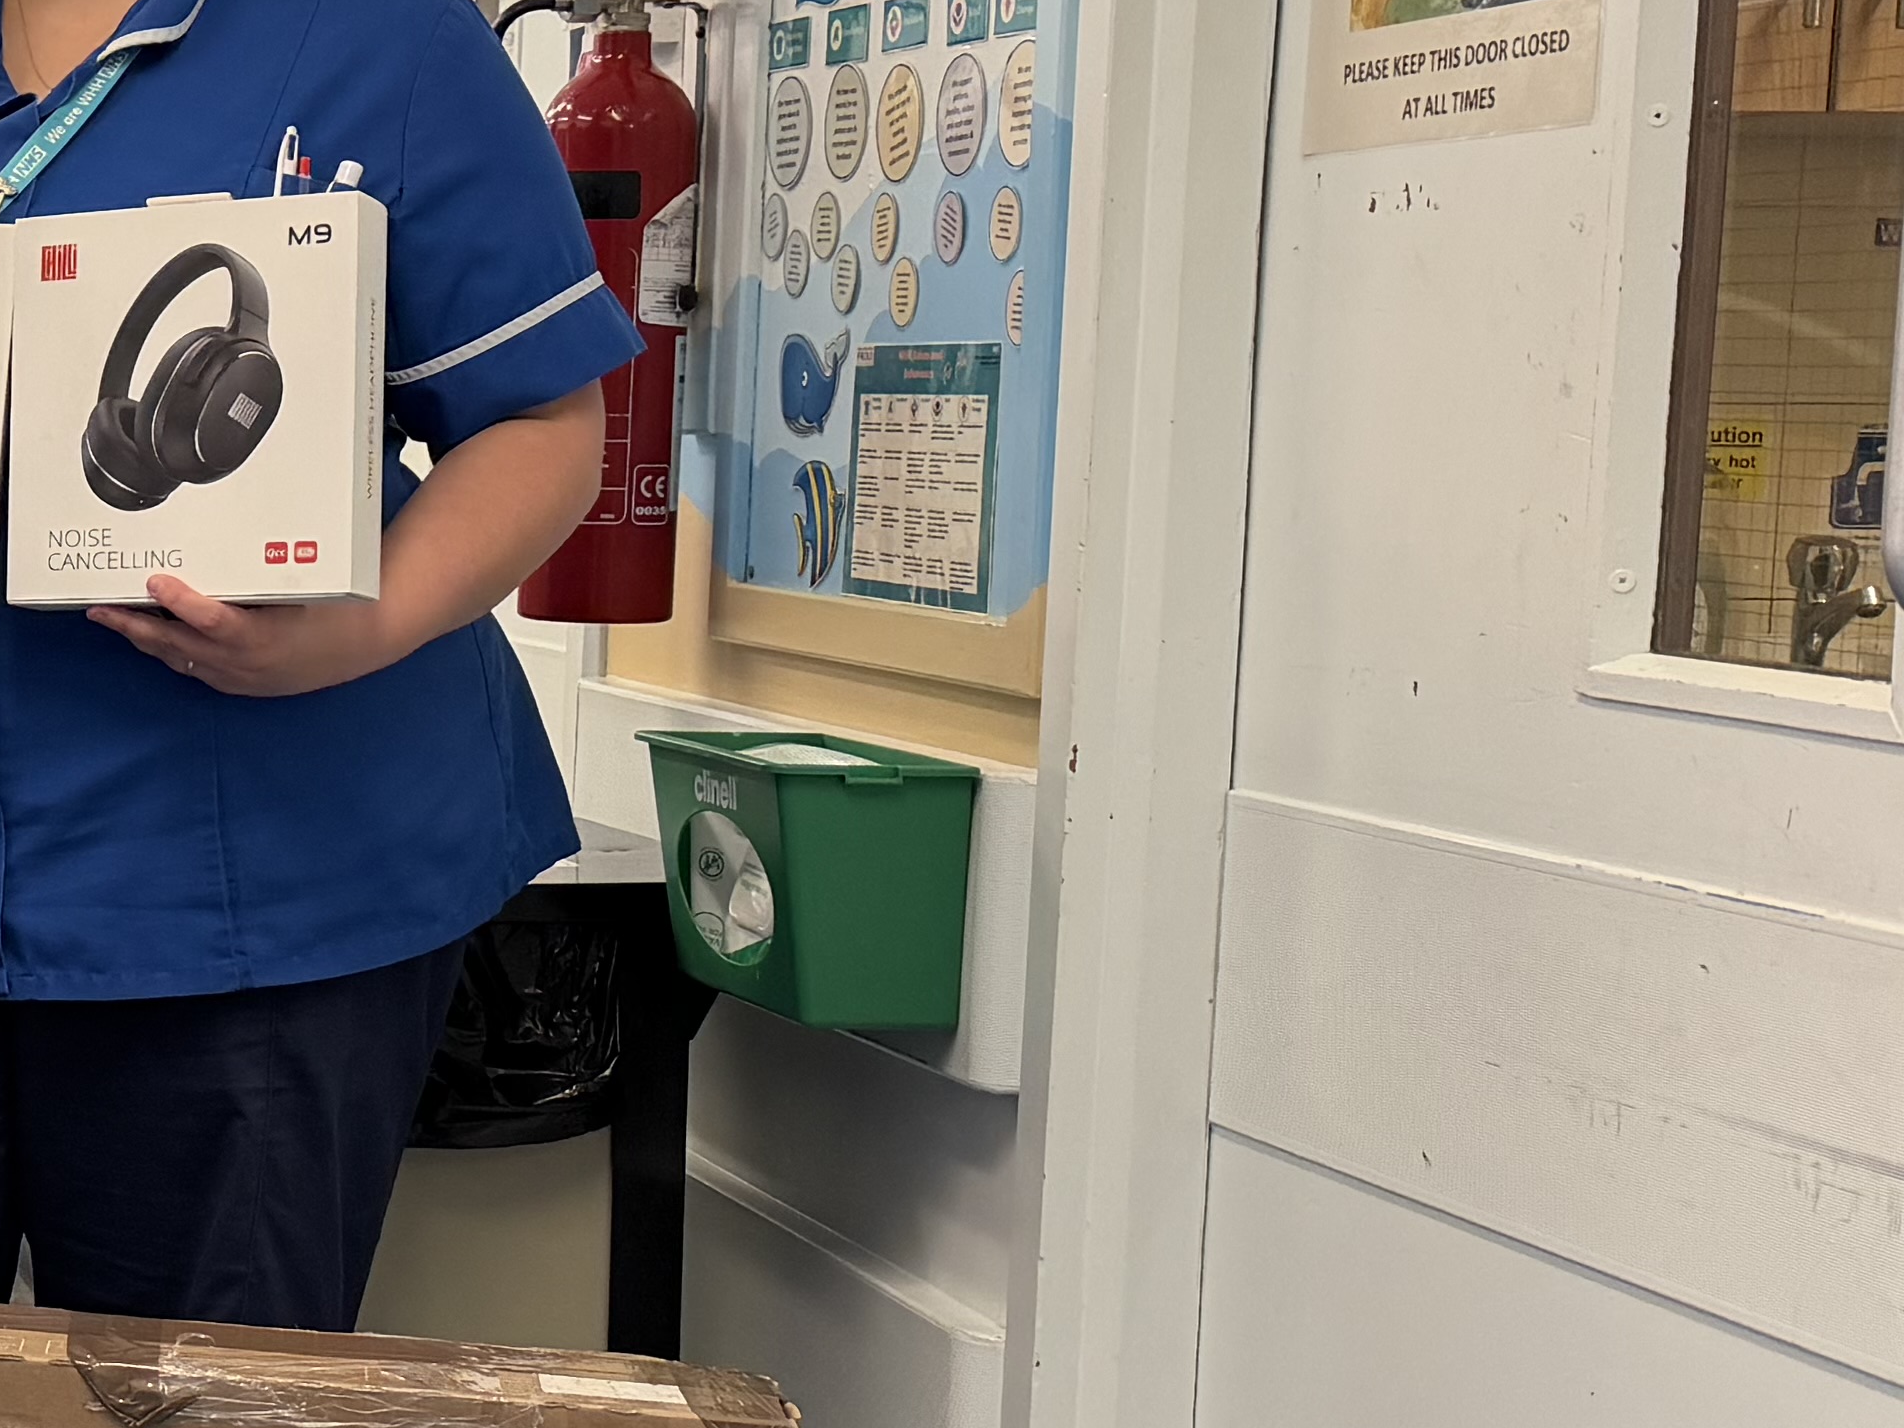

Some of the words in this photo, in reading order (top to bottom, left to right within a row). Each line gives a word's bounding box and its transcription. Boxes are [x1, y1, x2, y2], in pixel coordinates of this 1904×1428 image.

[1343, 54, 1390, 86] PLEASE
[1392, 49, 1426, 80] KEEP
[1429, 44, 1462, 74] THIS
[1463, 38, 1510, 70] DOOR
[1511, 27, 1571, 65] CLOSED
[1401, 97, 1422, 121] AT
[1424, 92, 1448, 118] ALL
[1450, 86, 1496, 115] TIMES
[12, 145, 47, 178] NHS
[44, 125, 67, 144] We
[63, 107, 83, 125] are
[77, 78, 106, 106] WHH
[288, 223, 334, 245] M9
[1709, 426, 1764, 444] ution
[1728, 454, 1756, 469] hot
[48, 528, 113, 548] NOISE
[47, 548, 183, 572] CANCELLING
[694, 768, 738, 811] clinell
